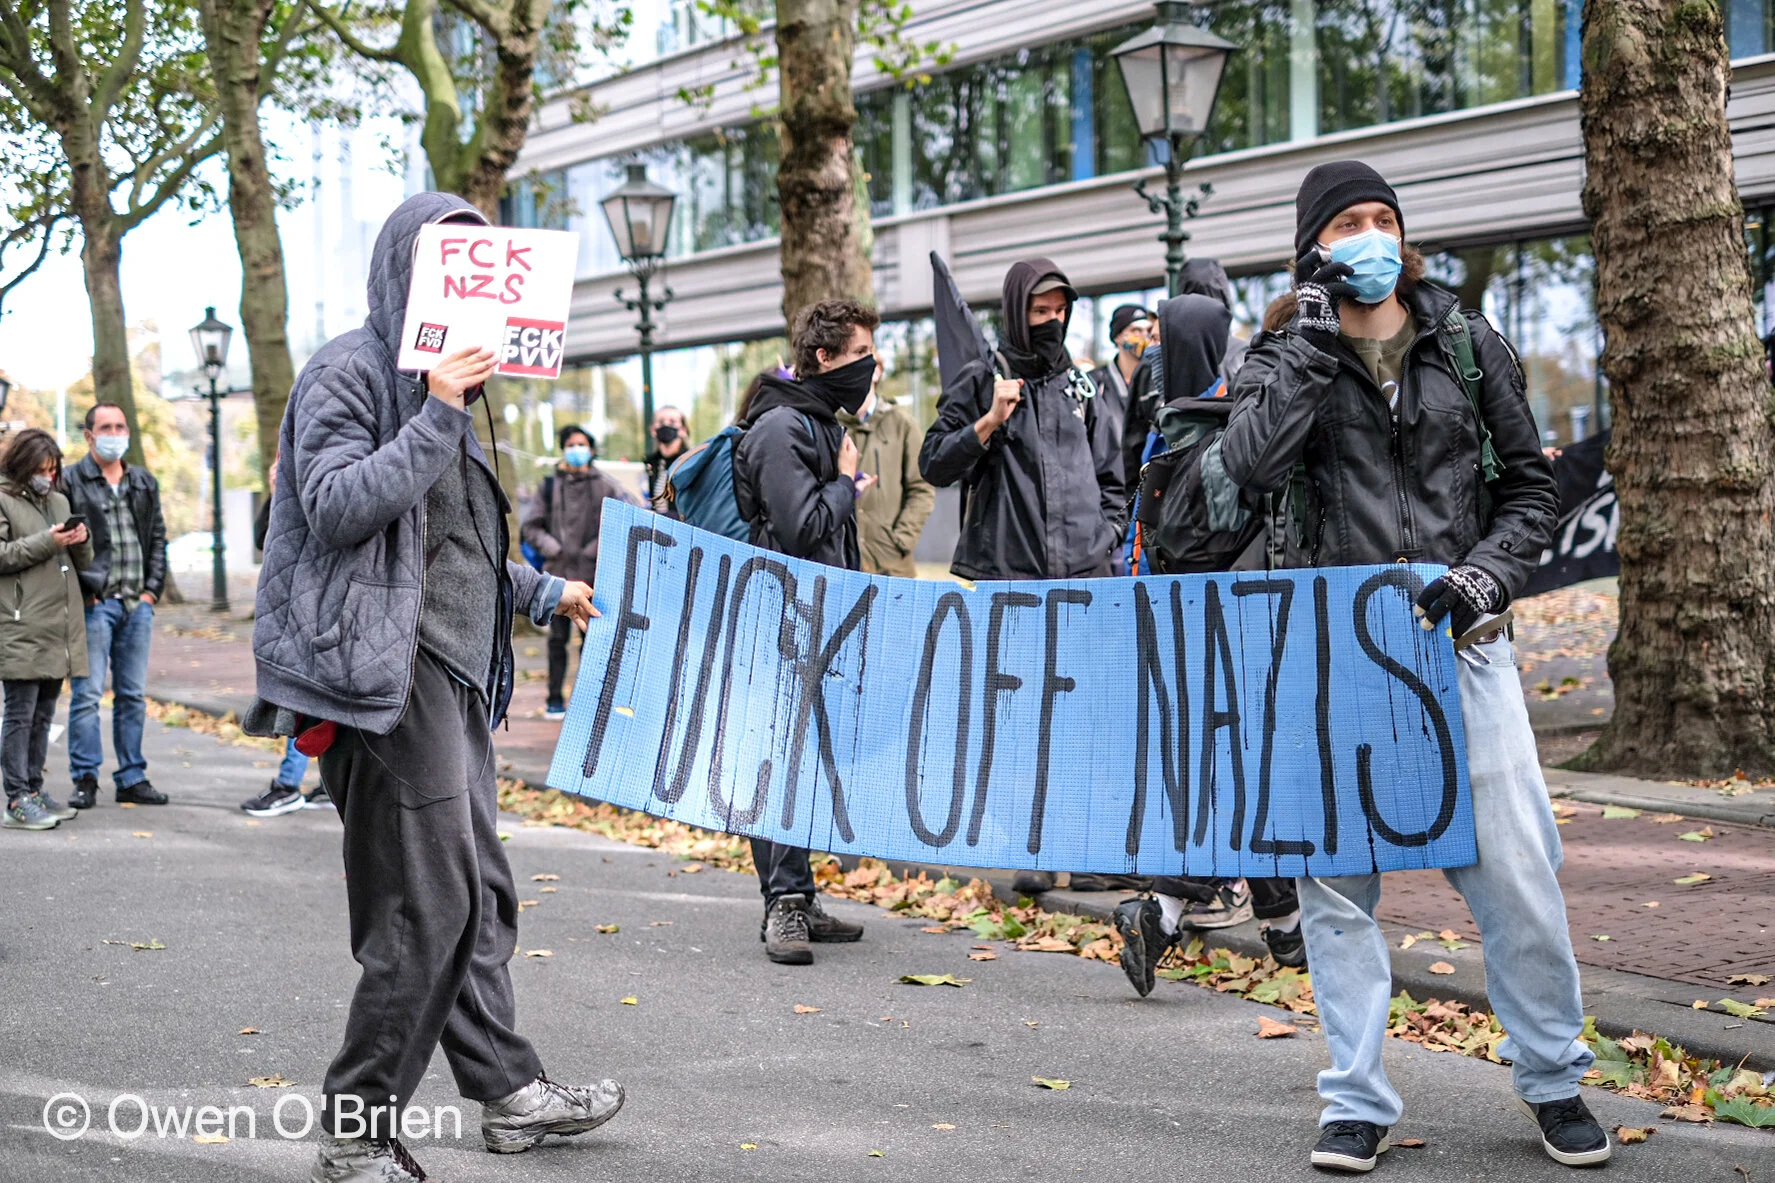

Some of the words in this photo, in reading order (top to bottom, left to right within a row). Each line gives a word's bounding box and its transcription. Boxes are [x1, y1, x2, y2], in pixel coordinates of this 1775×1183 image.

[441, 238, 532, 271] FCK
[444, 273, 524, 304] NZS
[418, 336, 442, 349] FVD
[421, 326, 445, 340] FCK
[504, 326, 562, 350] FCK
[501, 344, 561, 369] PVV
[583, 526, 878, 843] FUCK
[905, 588, 1093, 855] OFF
[1126, 567, 1458, 856] NAZIS
